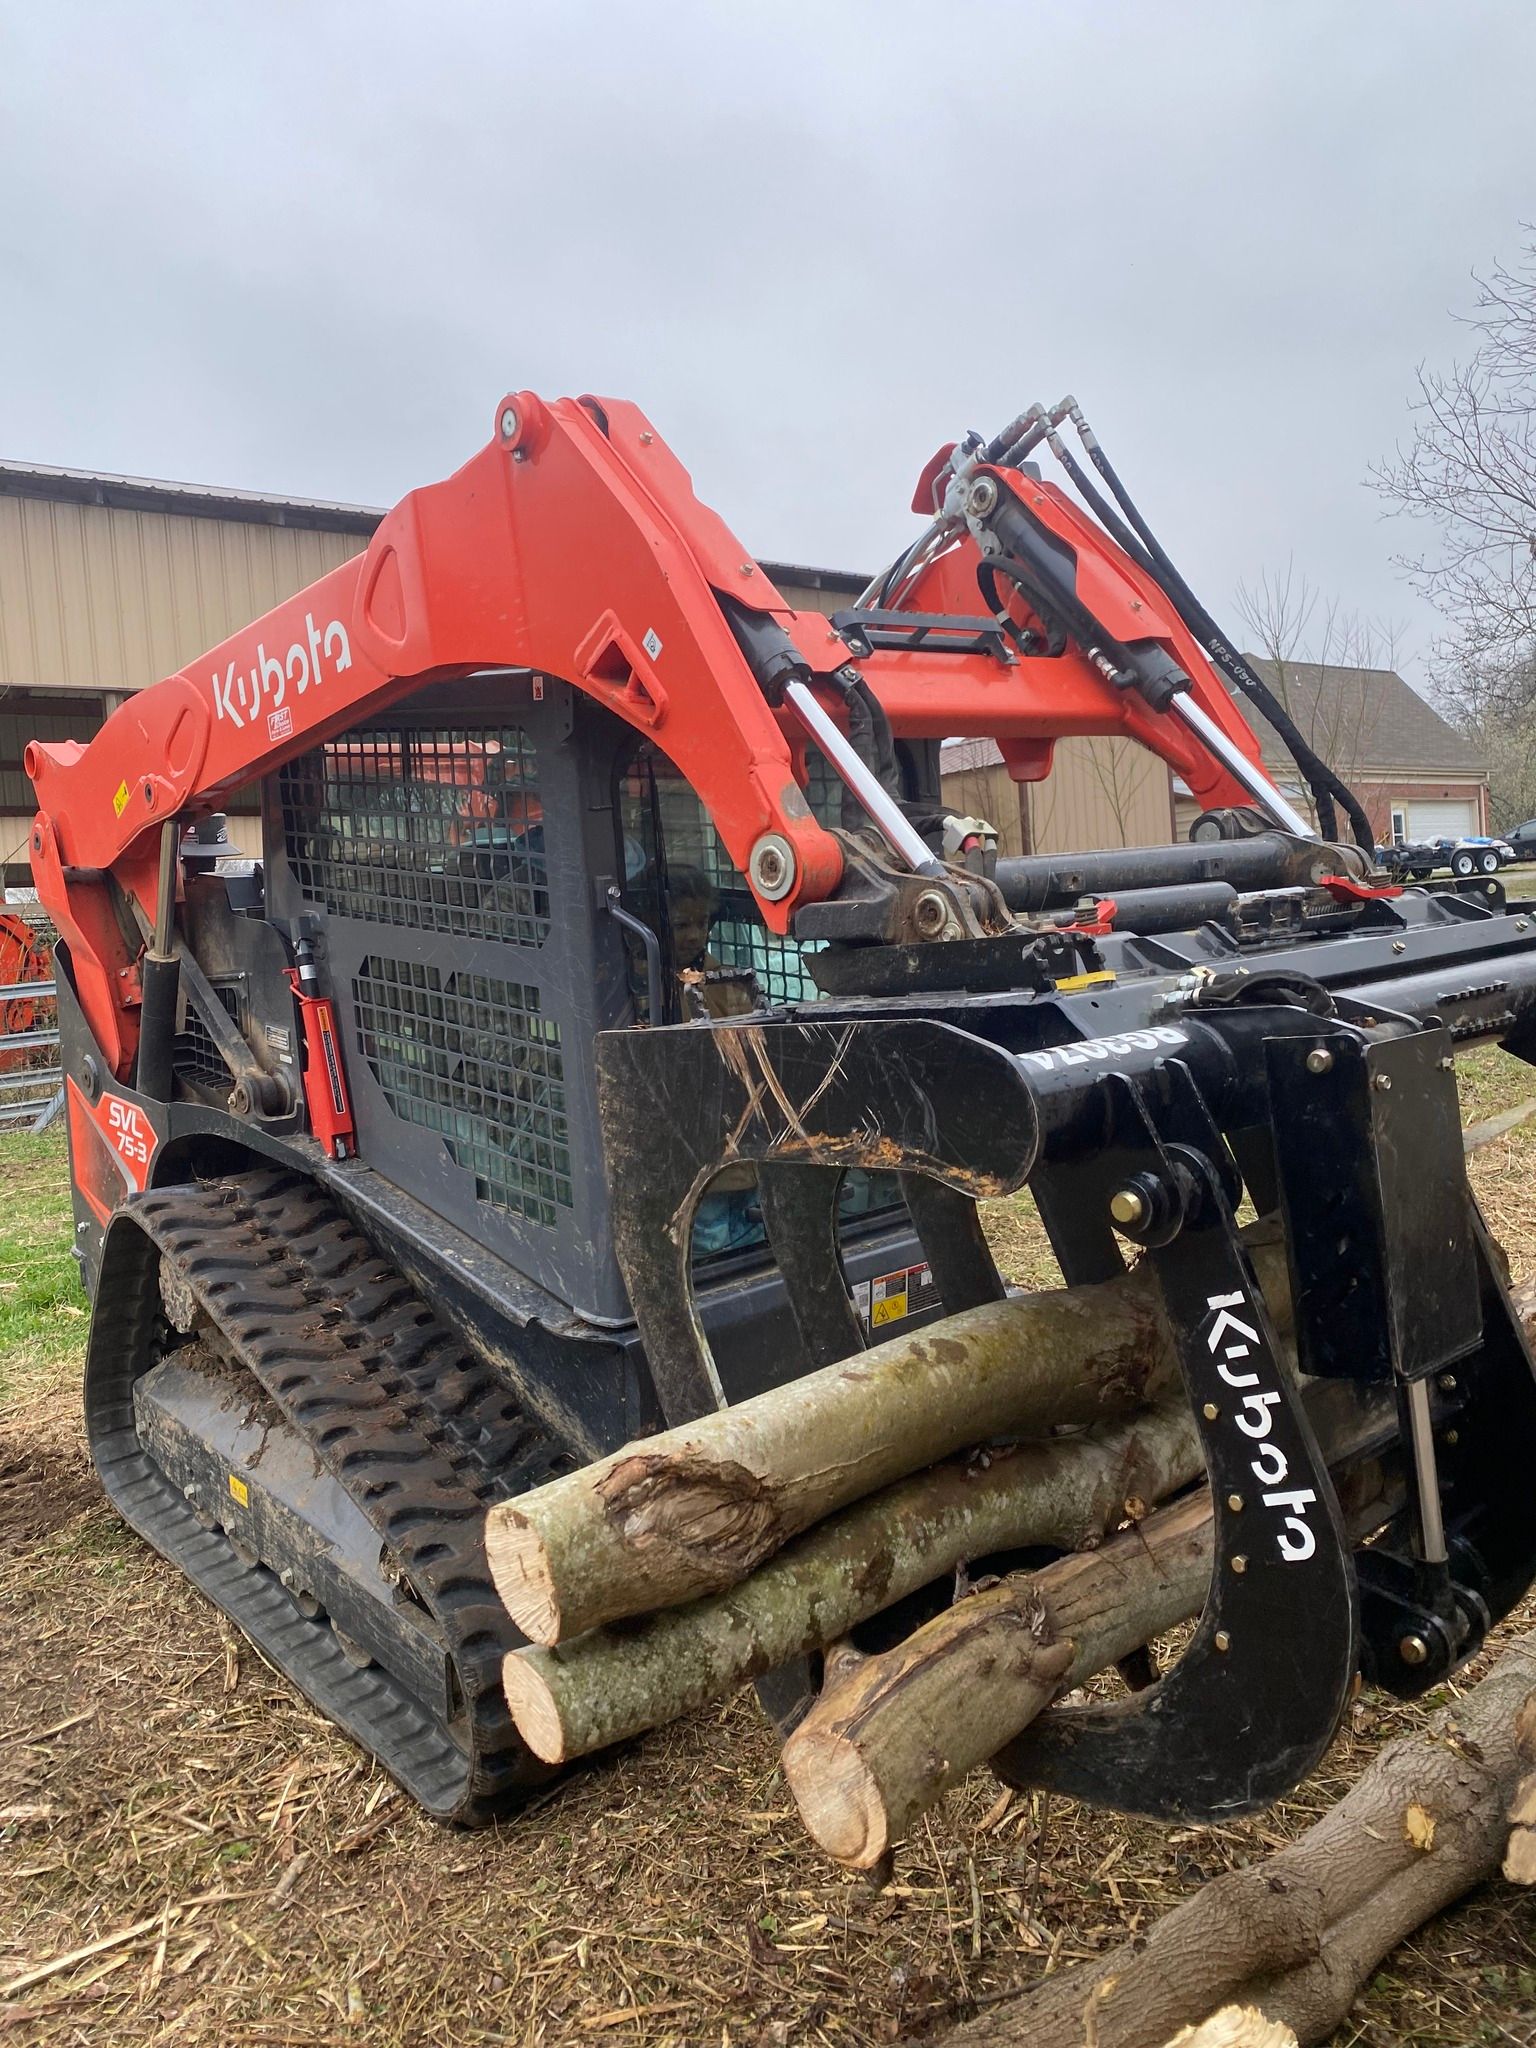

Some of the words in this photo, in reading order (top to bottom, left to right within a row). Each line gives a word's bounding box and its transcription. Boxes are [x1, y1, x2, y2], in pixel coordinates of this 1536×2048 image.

[212, 612, 352, 728] Kubota
[109, 1101, 143, 1139] SVL
[117, 1131, 147, 1163] 75-3
[1206, 1290, 1317, 1561] Kubota
